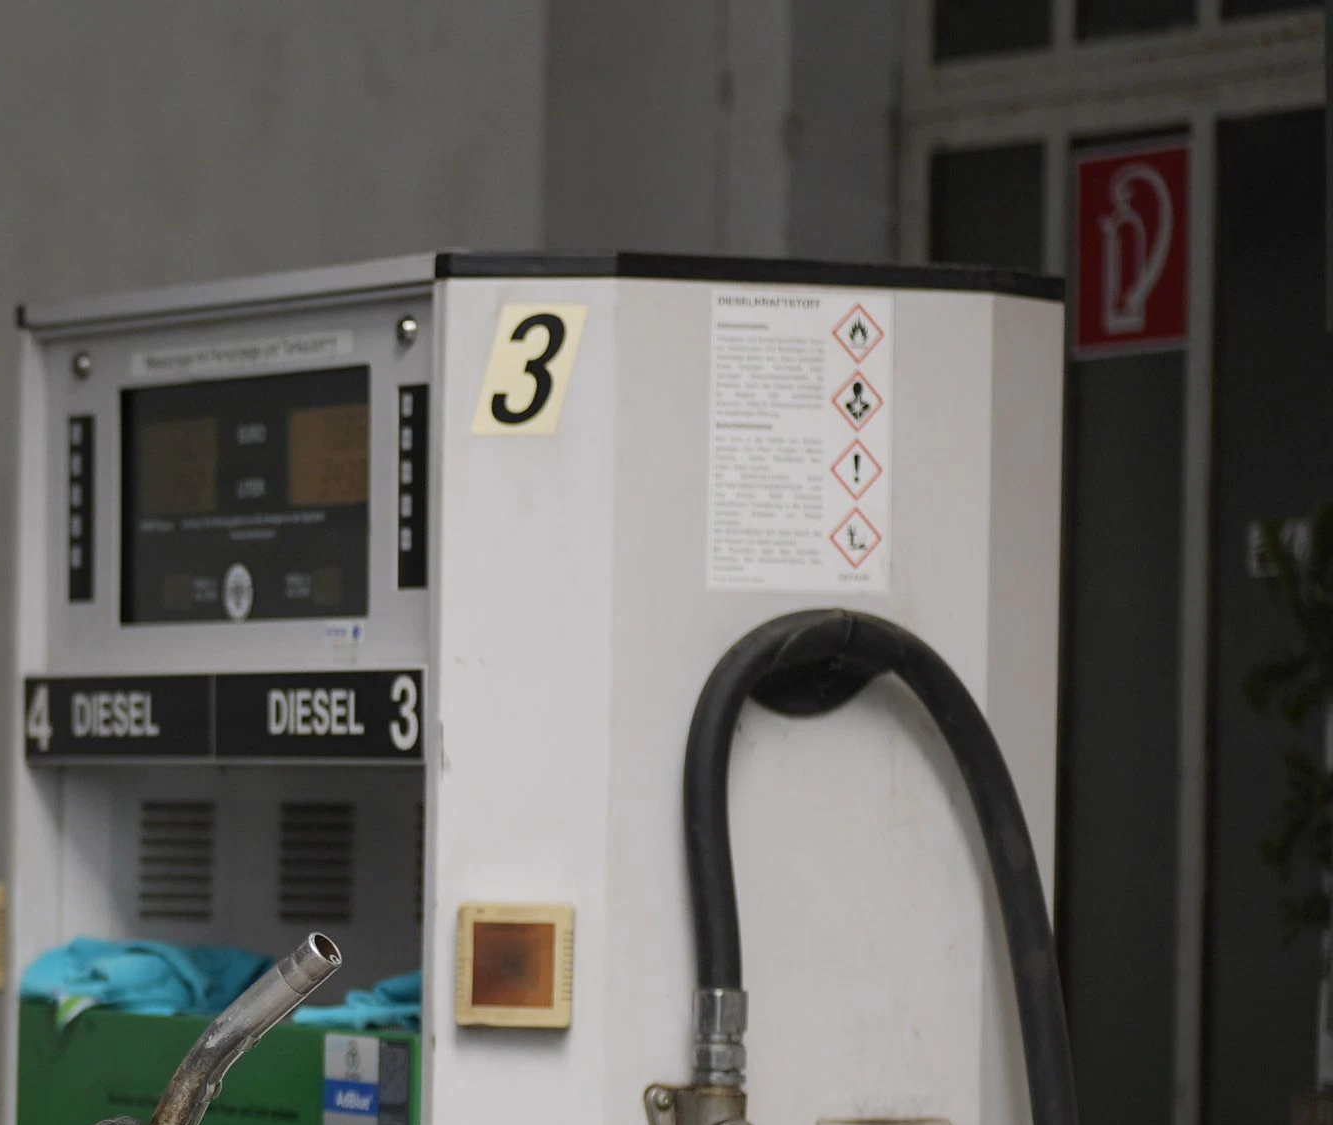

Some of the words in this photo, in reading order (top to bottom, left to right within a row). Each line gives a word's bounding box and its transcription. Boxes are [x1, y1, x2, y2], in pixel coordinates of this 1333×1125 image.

[491, 313, 567, 425] 3
[27, 683, 53, 752] 4
[71, 691, 161, 738] DIESEL
[267, 688, 365, 736] DIESEL
[389, 674, 420, 751] 3
